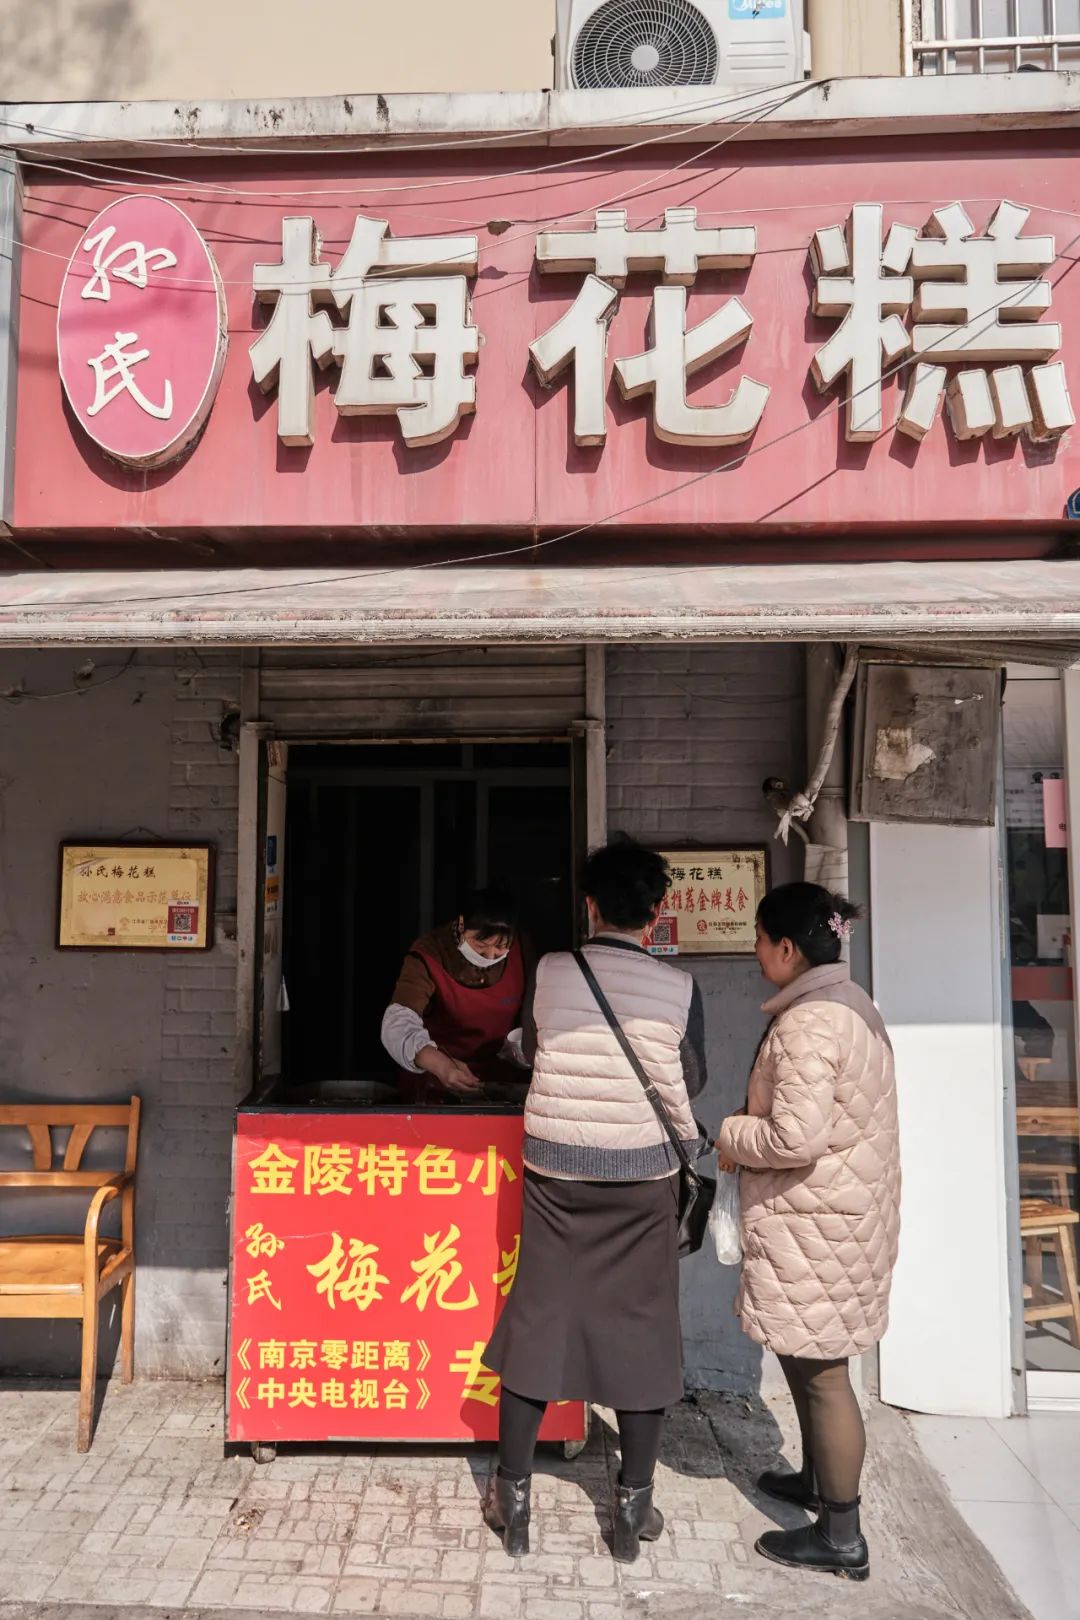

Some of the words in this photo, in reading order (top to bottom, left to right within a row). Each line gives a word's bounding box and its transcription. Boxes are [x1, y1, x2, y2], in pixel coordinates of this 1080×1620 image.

[82, 226, 178, 419] 孙氏
[249, 200, 1076, 448] 梅花糕
[79, 865, 157, 879] 孙氏梅花糕
[248, 1144, 517, 1196] 金陵特色小
[245, 1223, 285, 1311] 孙氏
[237, 1338, 431, 1371] 《南京零距离》
[235, 1377, 431, 1409] 《中央电视台》
